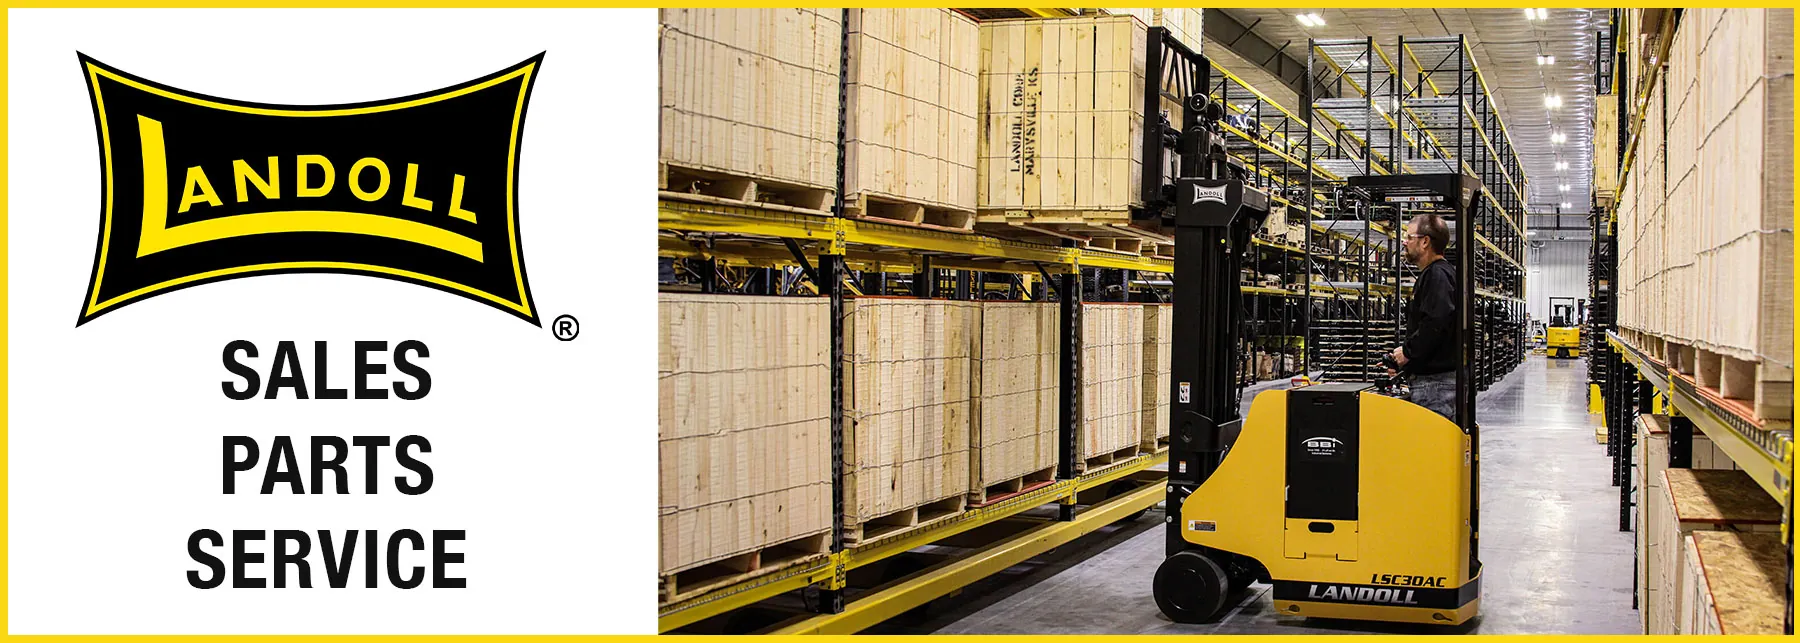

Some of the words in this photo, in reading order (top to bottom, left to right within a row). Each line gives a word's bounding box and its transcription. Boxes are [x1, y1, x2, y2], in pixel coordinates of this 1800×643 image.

[1197, 188, 1223, 200] LANDOLL
[1371, 574, 1447, 588] LSC30AC
[1308, 584, 1418, 605] LANDOLL
